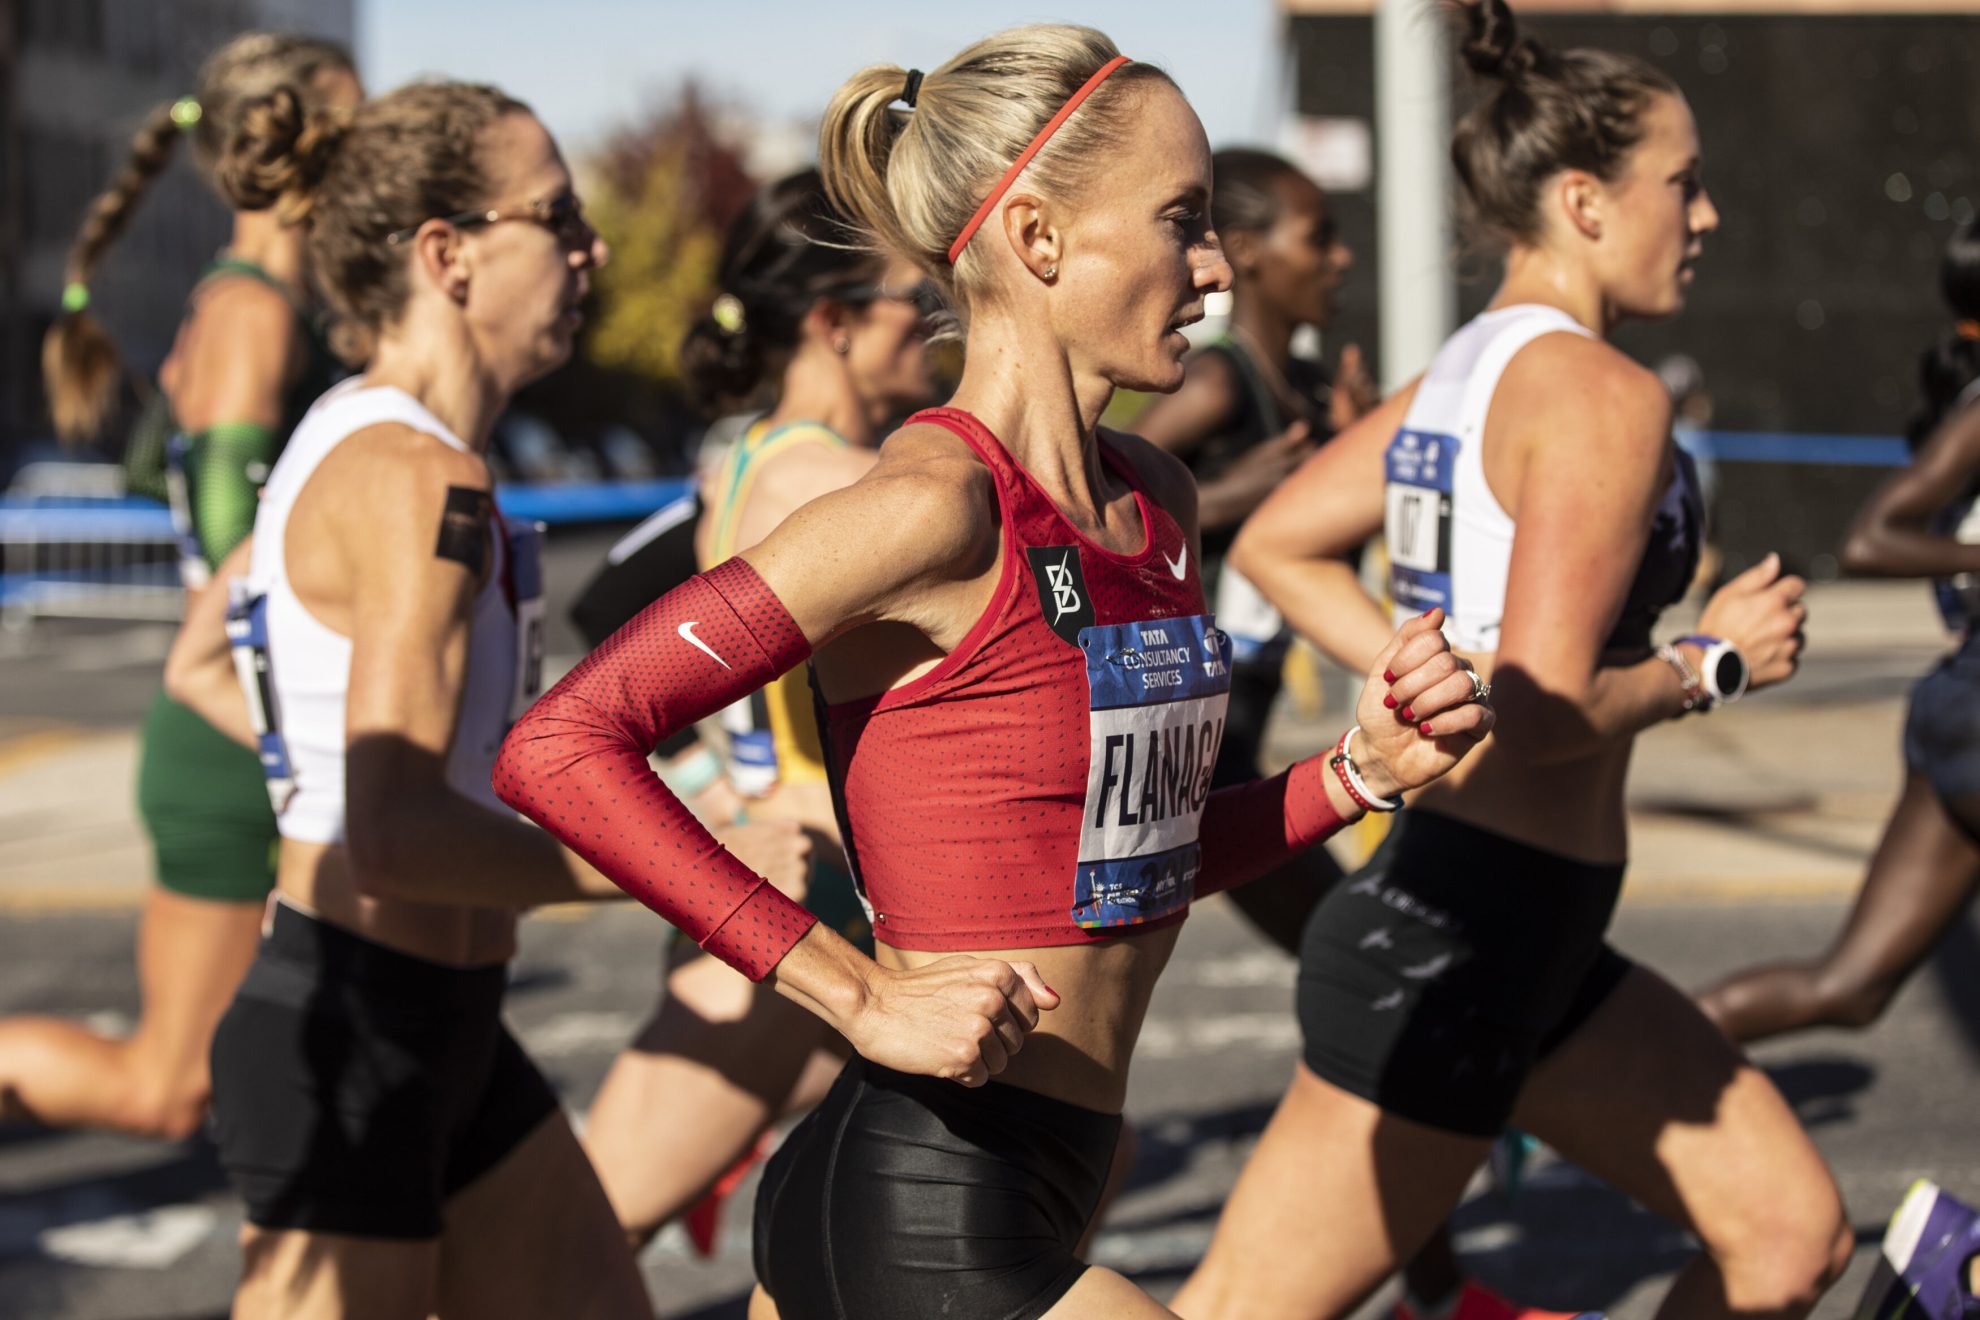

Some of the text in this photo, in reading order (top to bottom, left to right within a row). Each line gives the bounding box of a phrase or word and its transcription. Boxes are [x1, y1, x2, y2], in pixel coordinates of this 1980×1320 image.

[1140, 629, 1169, 646] TATA
[1123, 647, 1191, 671] CONSULTANCY
[1142, 669, 1183, 690] SERVICES
